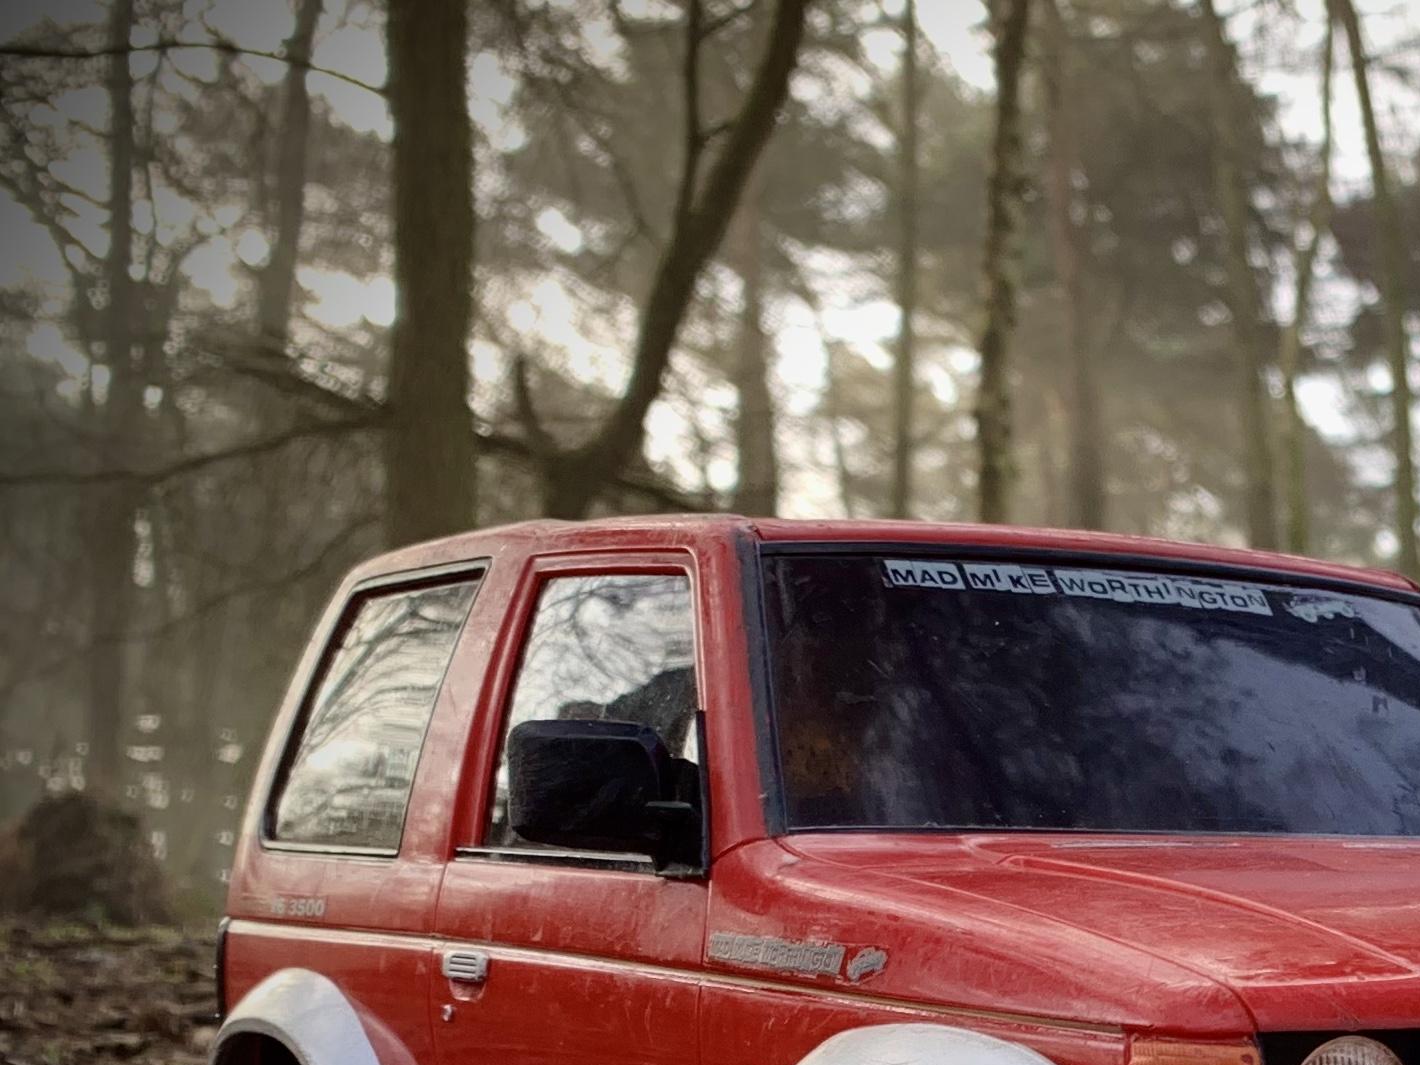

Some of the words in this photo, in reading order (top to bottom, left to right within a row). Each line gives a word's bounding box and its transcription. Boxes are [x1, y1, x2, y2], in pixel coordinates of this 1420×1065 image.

[890, 567, 960, 587] MAD
[1060, 575, 1268, 610] WORTHINGTON
[287, 898, 325, 916] 3500
